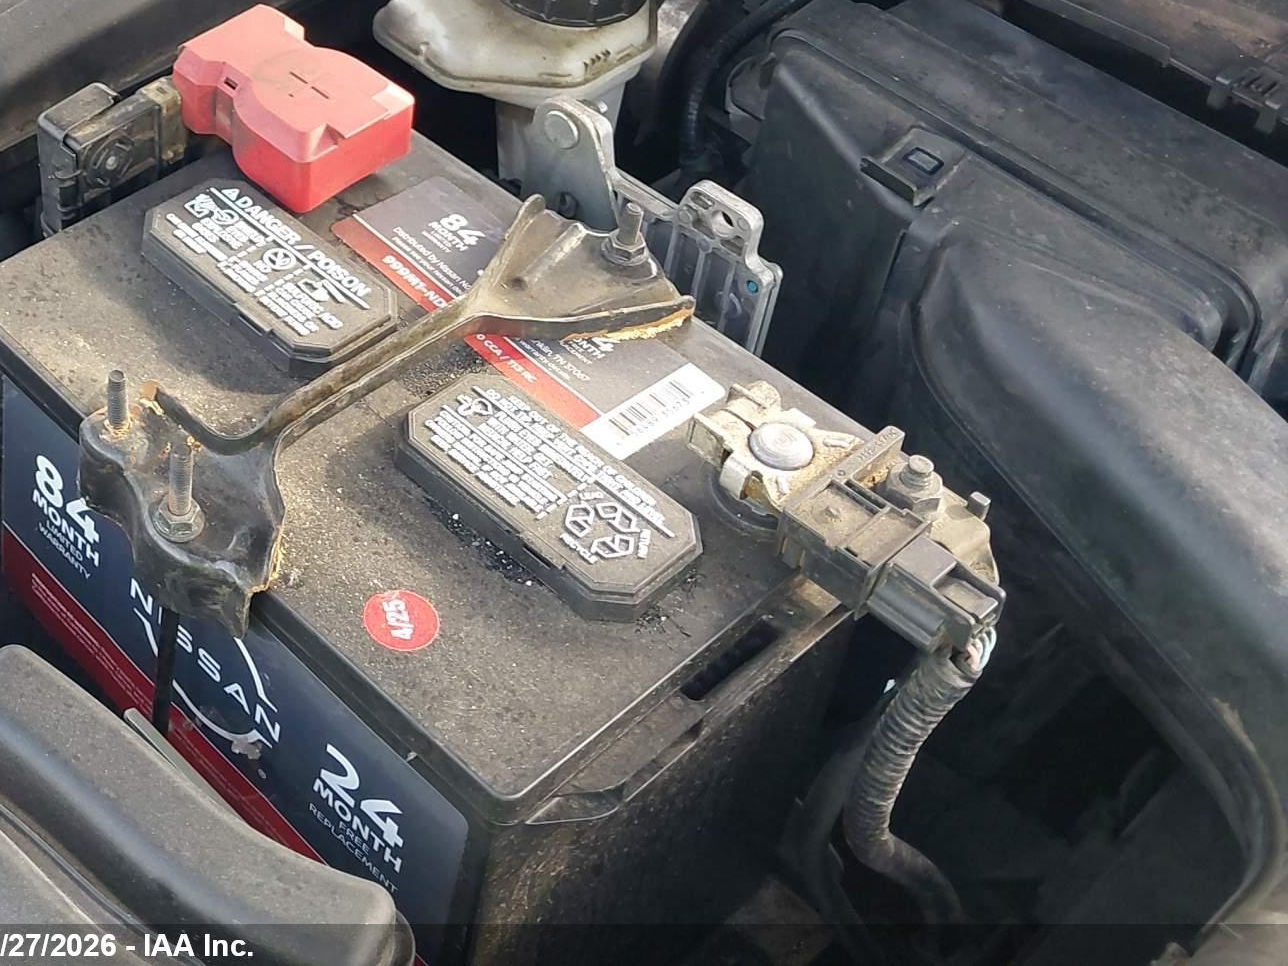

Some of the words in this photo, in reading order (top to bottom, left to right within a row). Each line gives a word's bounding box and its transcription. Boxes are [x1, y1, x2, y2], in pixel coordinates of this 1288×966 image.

[235, 194, 302, 244] DANGER
[308, 249, 373, 298] POISON
[428, 221, 469, 251] MONTH
[439, 214, 486, 246] 84
[391, 224, 433, 257] Distributed
[426, 253, 443, 265] by
[435, 261, 463, 283] Nissan
[481, 338, 505, 356] CCA
[518, 369, 539, 384] RC
[550, 352, 569, 366] TN
[562, 361, 592, 383] 37067
[527, 410, 548, 424] OUT
[34, 454, 100, 544] 84
[31, 489, 100, 569] MONTH
[38, 521, 92, 579] WARRANTY
[45, 519, 84, 560] LIMITED
[559, 533, 599, 565] RECYCLE
[381, 599, 415, 641] 4/25
[318, 743, 405, 848] 24
[308, 802, 399, 894] REPLACEMENT
[312, 778, 404, 874] MONTH
[338, 820, 370, 855] FREE
